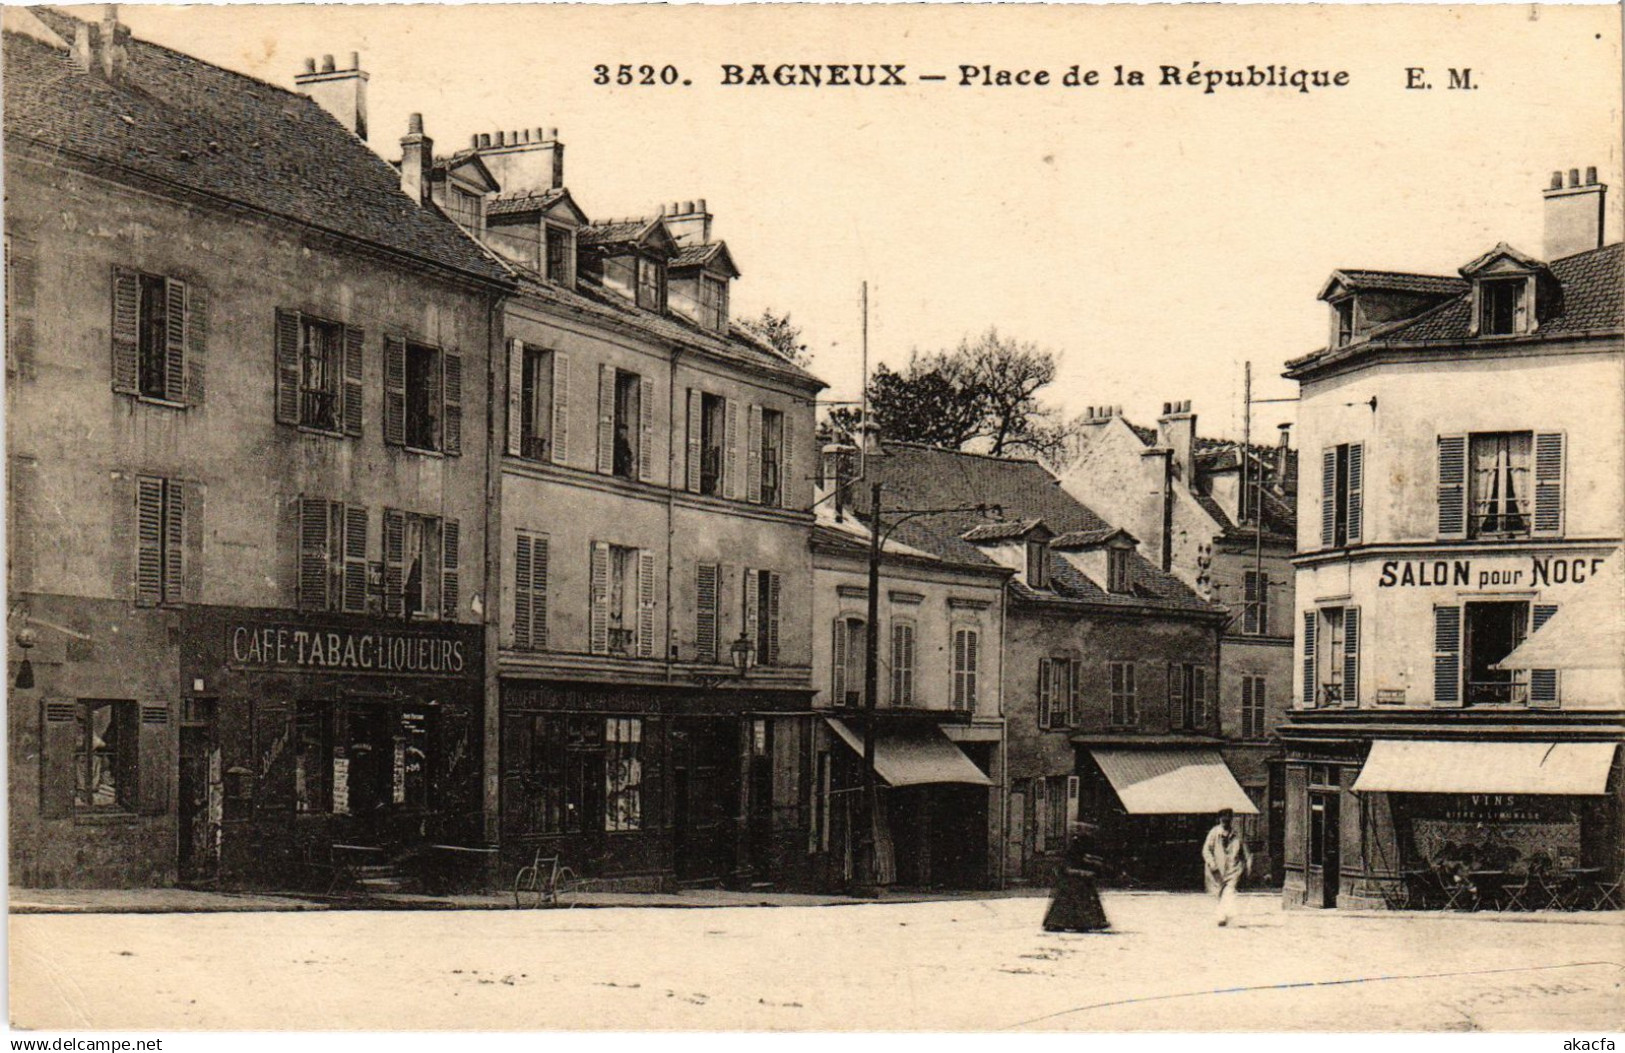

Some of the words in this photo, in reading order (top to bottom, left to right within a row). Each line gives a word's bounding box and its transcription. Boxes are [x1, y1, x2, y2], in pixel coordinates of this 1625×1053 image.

[1378, 560, 1470, 588] SALON
[1479, 567, 1523, 589] pour
[294, 631, 373, 668] TABAC
[377, 635, 464, 672] LIQUEURS
[1471, 794, 1515, 806] VINS
